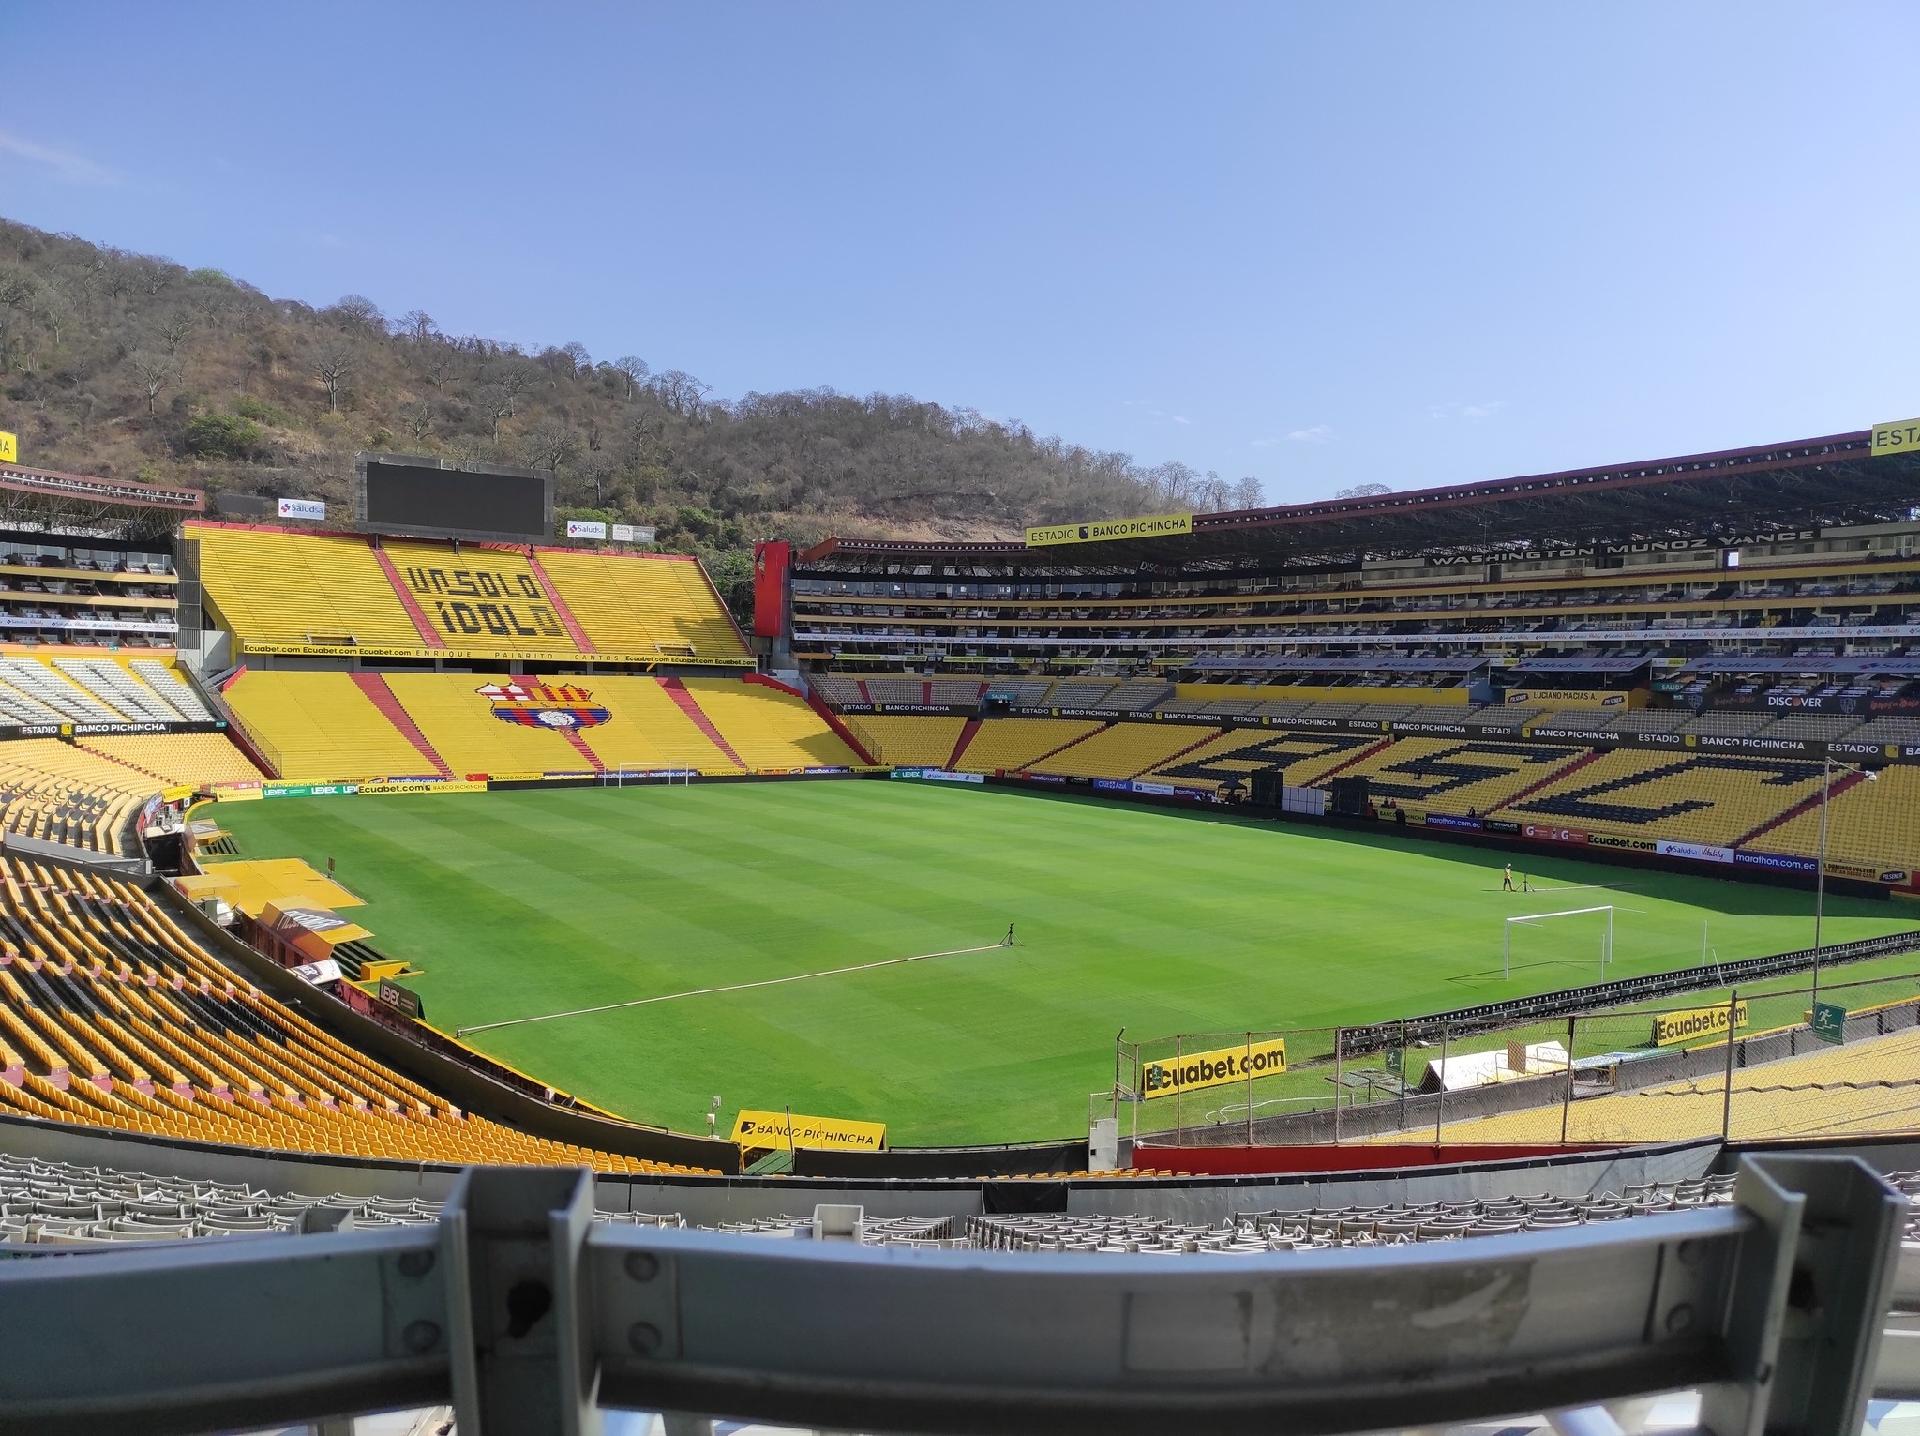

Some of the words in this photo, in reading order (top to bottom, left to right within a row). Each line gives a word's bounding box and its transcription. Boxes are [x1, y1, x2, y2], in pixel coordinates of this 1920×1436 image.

[1876, 426, 1920, 447] EST
[1031, 530, 1074, 541] ESTADIO
[1092, 524, 1128, 537] BANCO
[1130, 519, 1186, 533] PICHINCHA
[1432, 548, 1594, 566] WASHINGTON
[1718, 531, 1814, 546] YANCE
[245, 645, 300, 653] Ecuabet.com
[359, 648, 411, 656] Ecuabet.com
[1767, 696, 1822, 707] DISCOVER
[23, 725, 57, 734] ESTADIO
[76, 724, 109, 733] BANCO
[111, 723, 166, 731] PICHINCHA
[1393, 723, 1419, 731] BANCO
[1421, 724, 1466, 733] PICHINCHA
[1567, 731, 1619, 740] PICHINCHA
[1638, 734, 1680, 743] ESTADIO
[1701, 737, 1740, 746] BANCO
[1742, 739, 1805, 749] PICHINCHA
[1828, 744, 1878, 753] ESTADIO
[1427, 817, 1481, 829] marathon.com.ec
[1587, 834, 1657, 851] Ecuabet.com
[1735, 853, 1816, 871] marathon.com.ec
[1146, 1050, 1284, 1092] Ecuabet.com
[757, 1124, 801, 1138] BANCO
[804, 1129, 874, 1145] PICHINCHA
